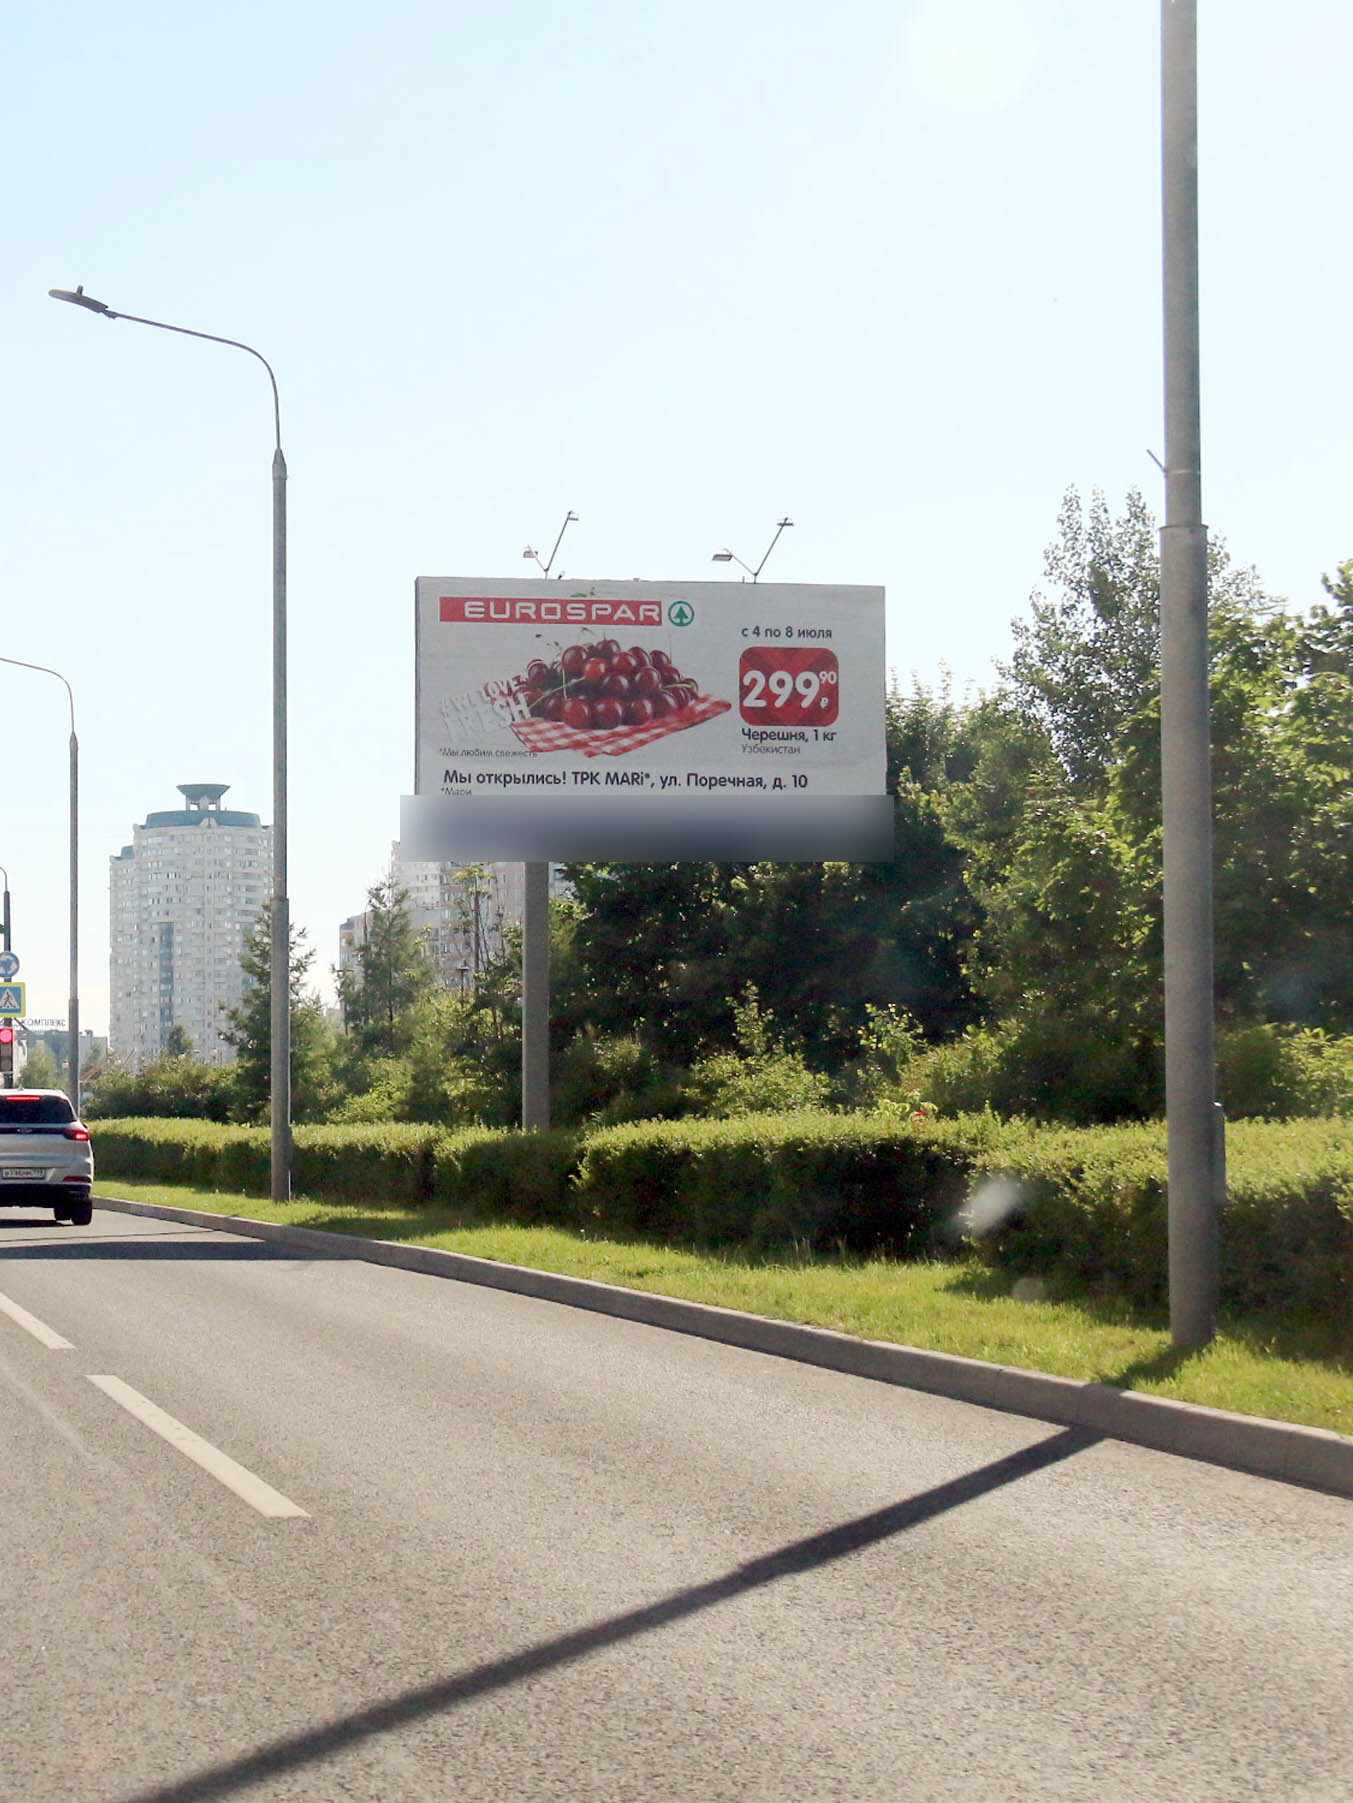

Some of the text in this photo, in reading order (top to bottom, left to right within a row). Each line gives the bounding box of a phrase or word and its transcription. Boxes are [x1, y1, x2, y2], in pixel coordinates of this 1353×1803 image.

[464, 600, 660, 622] EUROSPAR
[741, 625, 832, 639] с 4 по 8 июля
[480, 673, 527, 702] LOVE
[743, 669, 820, 709] 299
[741, 728, 837, 743] Черешня, 1 кг
[460, 748, 493, 757] любим
[495, 750, 538, 758] свежесть
[741, 743, 800, 754] Узбекистан
[443, 769, 471, 784] Мы
[476, 770, 566, 788] открылись!
[571, 771, 600, 785] ТРК
[659, 775, 681, 790] ул.
[686, 772, 767, 790] Поречная,
[772, 776, 787, 790] д.
[791, 774, 808, 788] 10
[21, 1018, 66, 1027] КОМПЛЕКС
